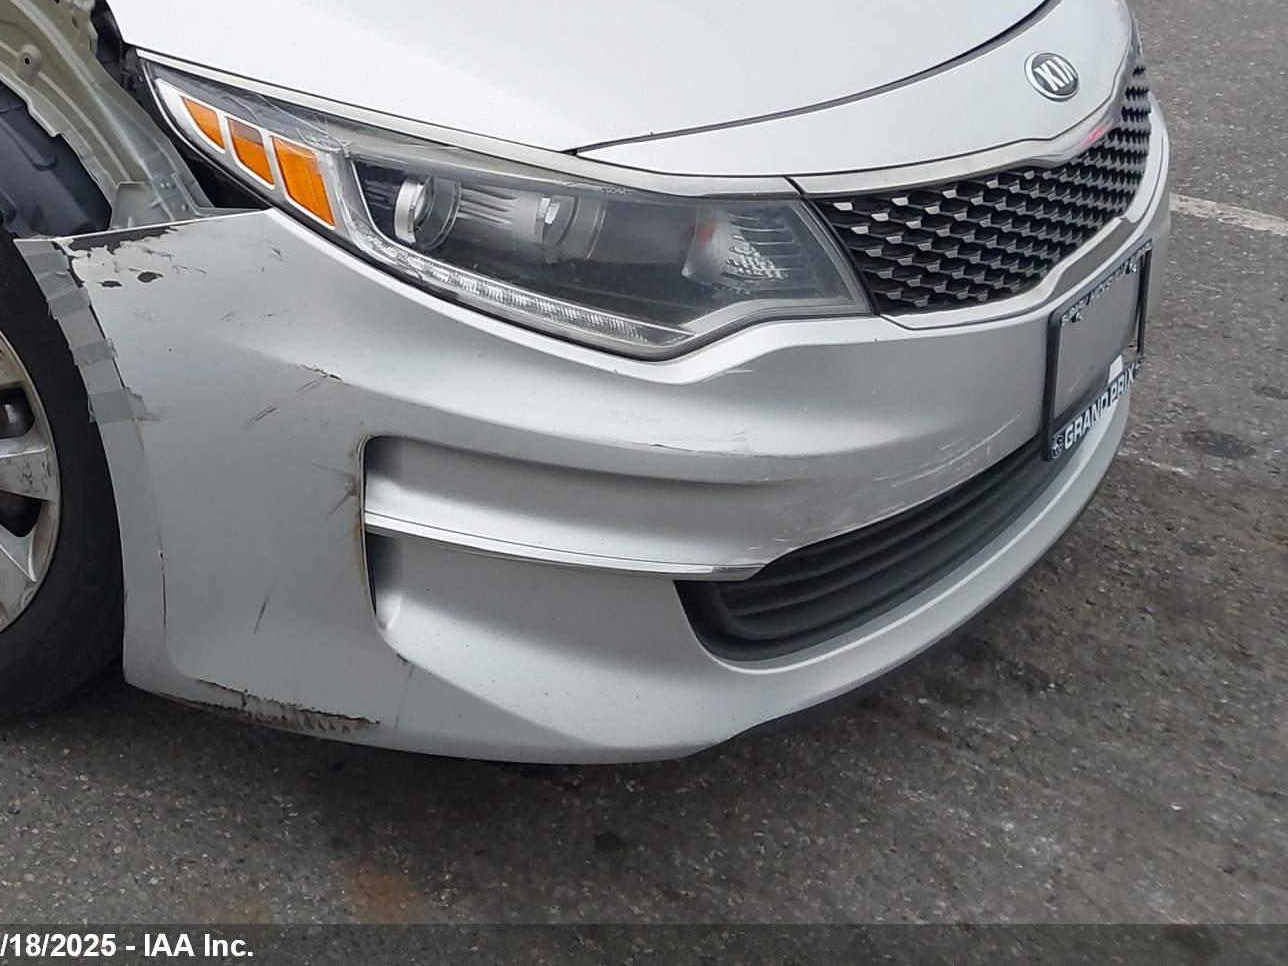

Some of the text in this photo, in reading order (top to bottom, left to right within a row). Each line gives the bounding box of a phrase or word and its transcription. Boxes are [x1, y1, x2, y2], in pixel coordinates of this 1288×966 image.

[1033, 55, 1075, 92] KIA
[1064, 362, 1135, 451] GRAND PRIX
